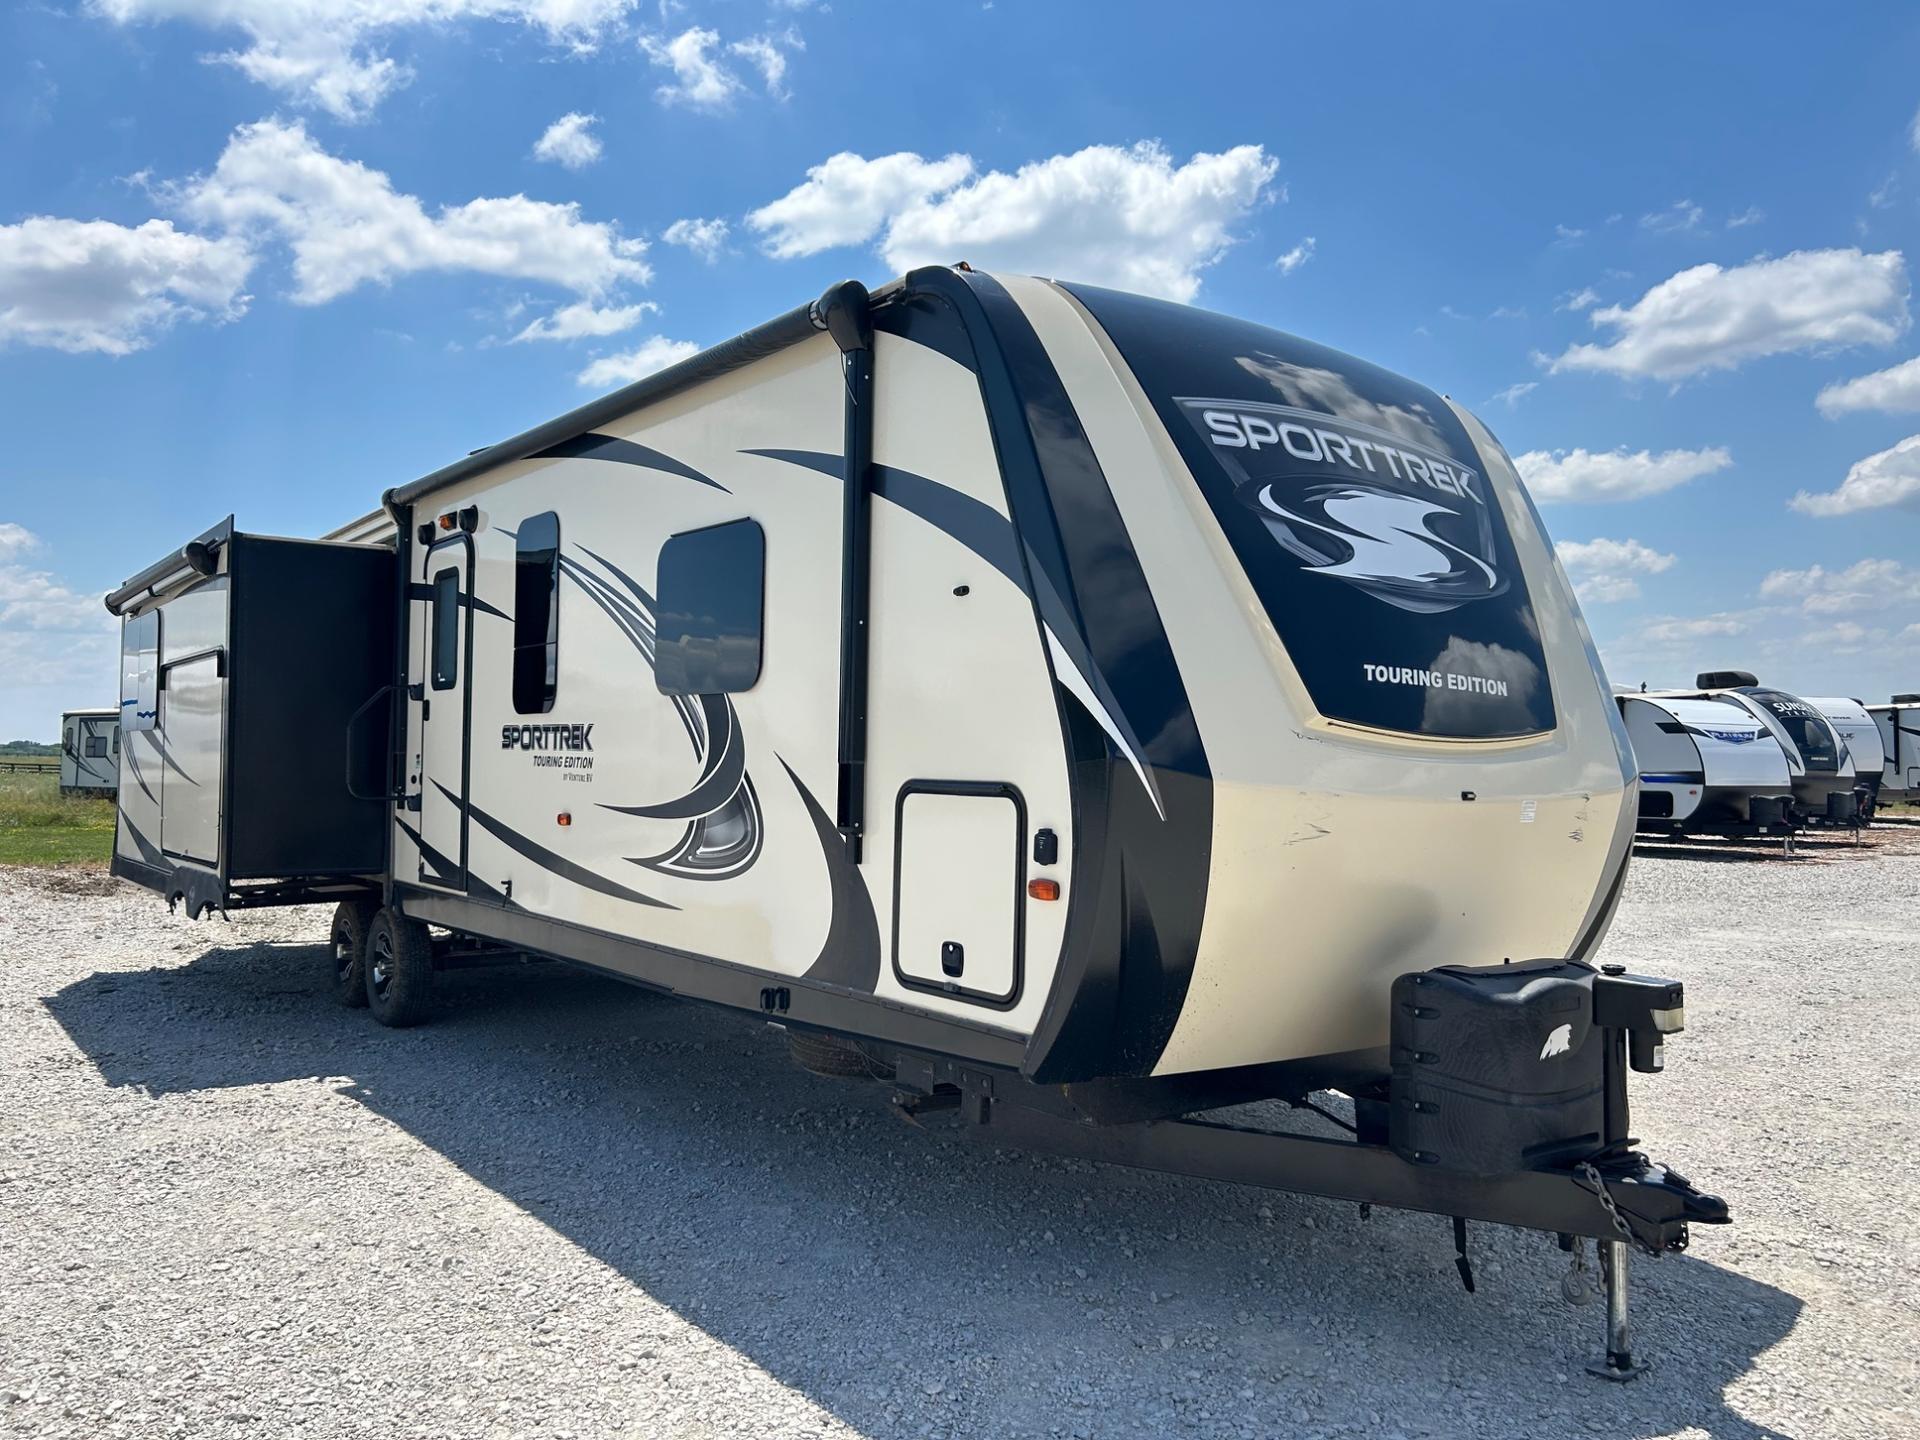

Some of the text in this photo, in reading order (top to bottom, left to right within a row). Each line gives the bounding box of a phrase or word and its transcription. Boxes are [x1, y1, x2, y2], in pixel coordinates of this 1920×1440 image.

[1202, 409, 1483, 505] SPORTTREK
[1363, 663, 1508, 697] TOURING EDITION
[501, 723, 594, 752] SPORTTREK
[533, 755, 594, 769] TOURING EDITION
